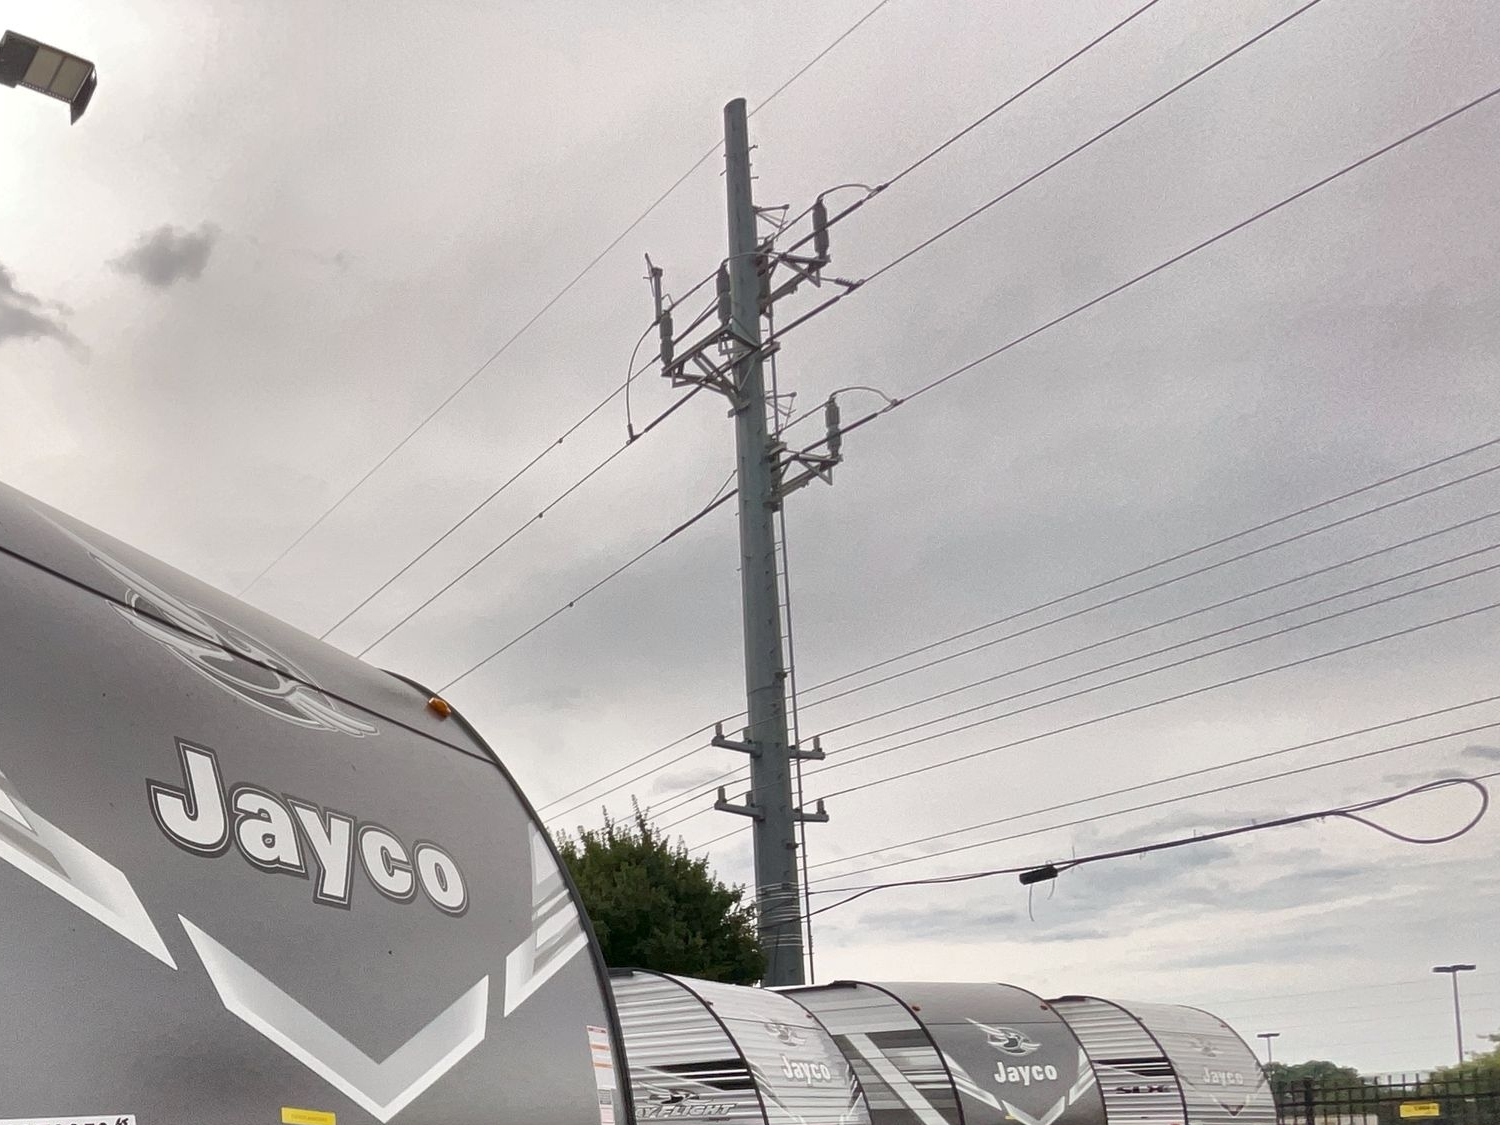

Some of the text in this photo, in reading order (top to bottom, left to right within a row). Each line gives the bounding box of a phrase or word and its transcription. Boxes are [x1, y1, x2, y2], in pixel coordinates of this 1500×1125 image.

[148, 740, 467, 914] Jayco
[781, 1054, 831, 1085] Jayco
[993, 1061, 1058, 1086] Jayco
[1203, 1066, 1243, 1087] Jayco
[657, 1104, 737, 1118] FLIGHT
